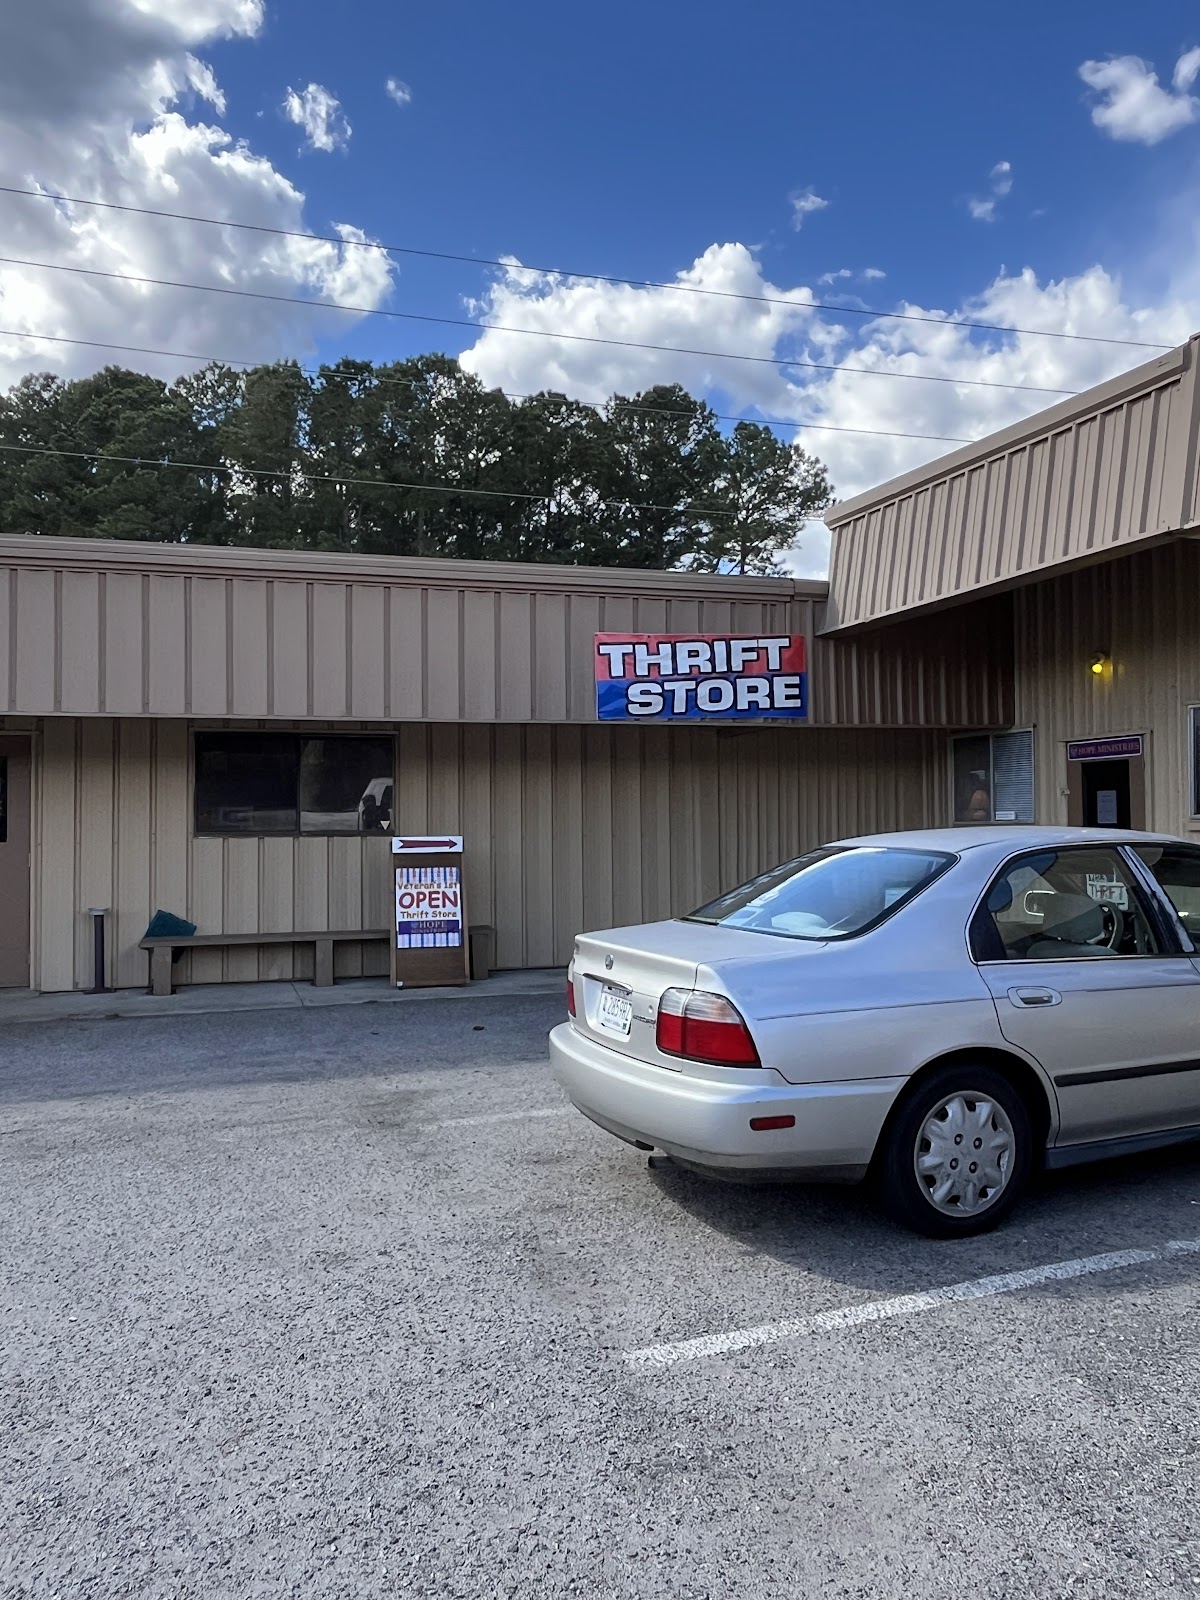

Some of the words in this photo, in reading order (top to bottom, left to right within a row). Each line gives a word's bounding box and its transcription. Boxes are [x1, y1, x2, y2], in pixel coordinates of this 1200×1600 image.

[599, 637, 790, 678] THRIFT
[627, 675, 802, 715] STORE
[1098, 741, 1139, 753] MINISTRIES
[398, 890, 459, 909] OPEN
[400, 910, 429, 919] Thrift
[431, 910, 457, 918] Store
[419, 920, 448, 929] HOPE
